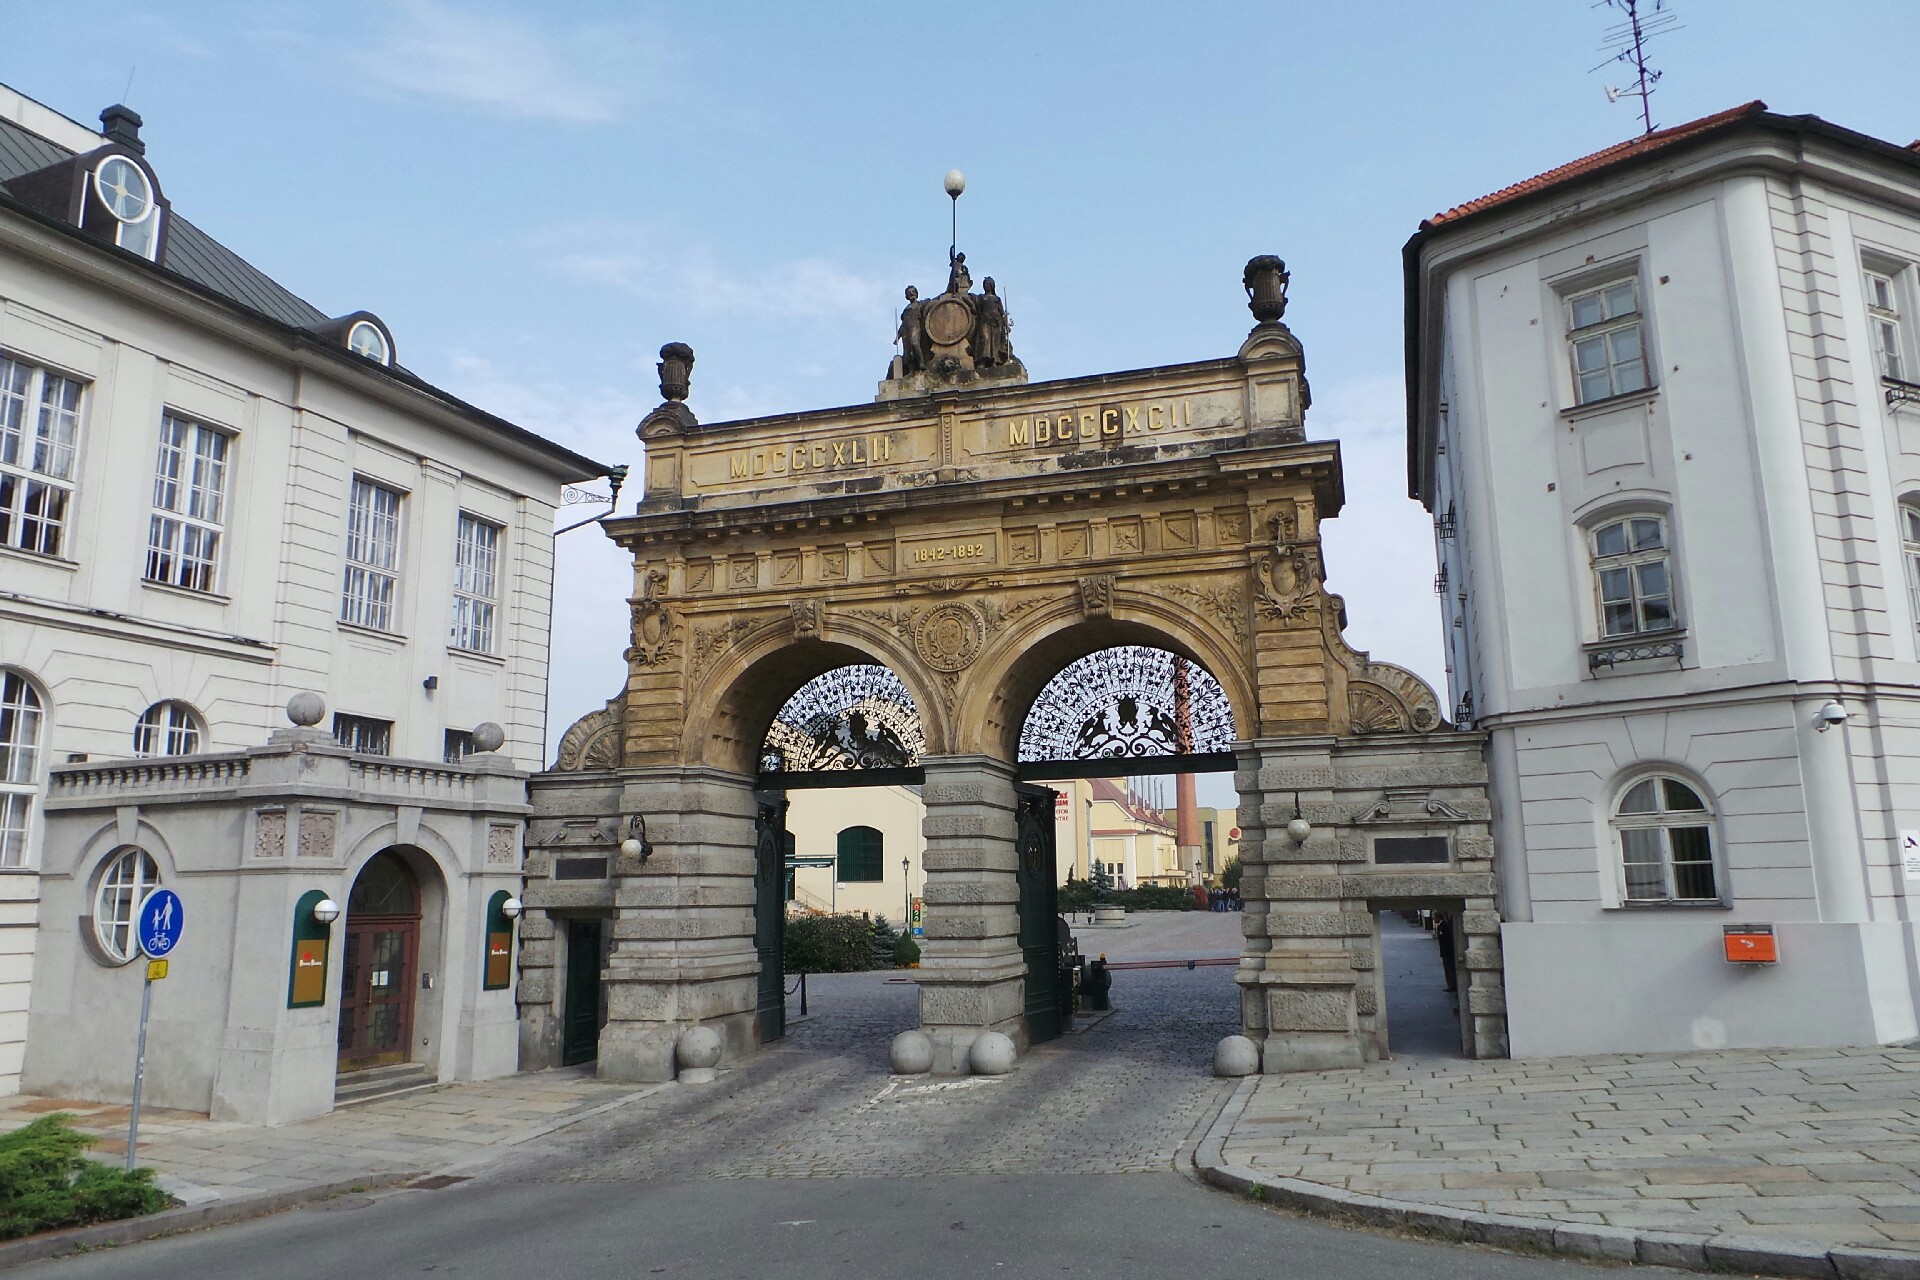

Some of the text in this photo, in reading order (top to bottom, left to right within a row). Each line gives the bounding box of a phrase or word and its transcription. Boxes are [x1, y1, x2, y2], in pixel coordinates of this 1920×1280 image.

[1008, 400, 1191, 446] MDCCCXCII
[730, 436, 890, 478] MDCCCXLII
[914, 543, 984, 562] 1842-1892
